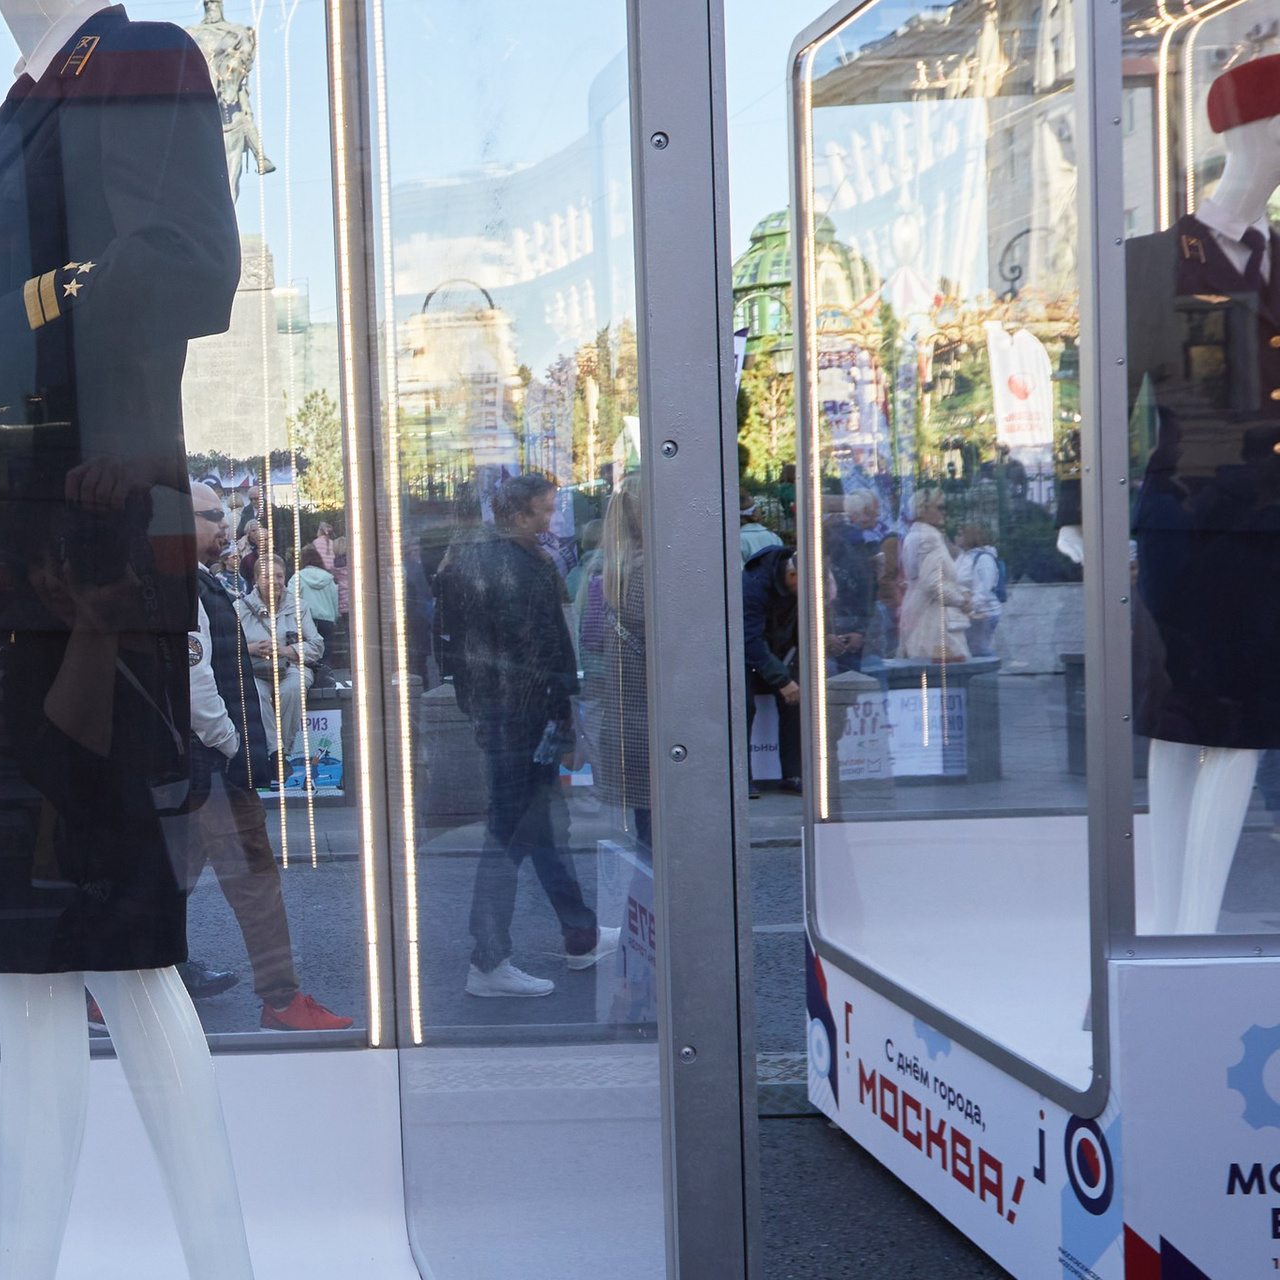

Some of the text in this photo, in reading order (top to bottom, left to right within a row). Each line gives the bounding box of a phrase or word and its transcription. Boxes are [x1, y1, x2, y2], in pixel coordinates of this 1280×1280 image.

[858, 1057, 1026, 1226] МОСКВА!
[885, 1038, 986, 1133] С днём города,
